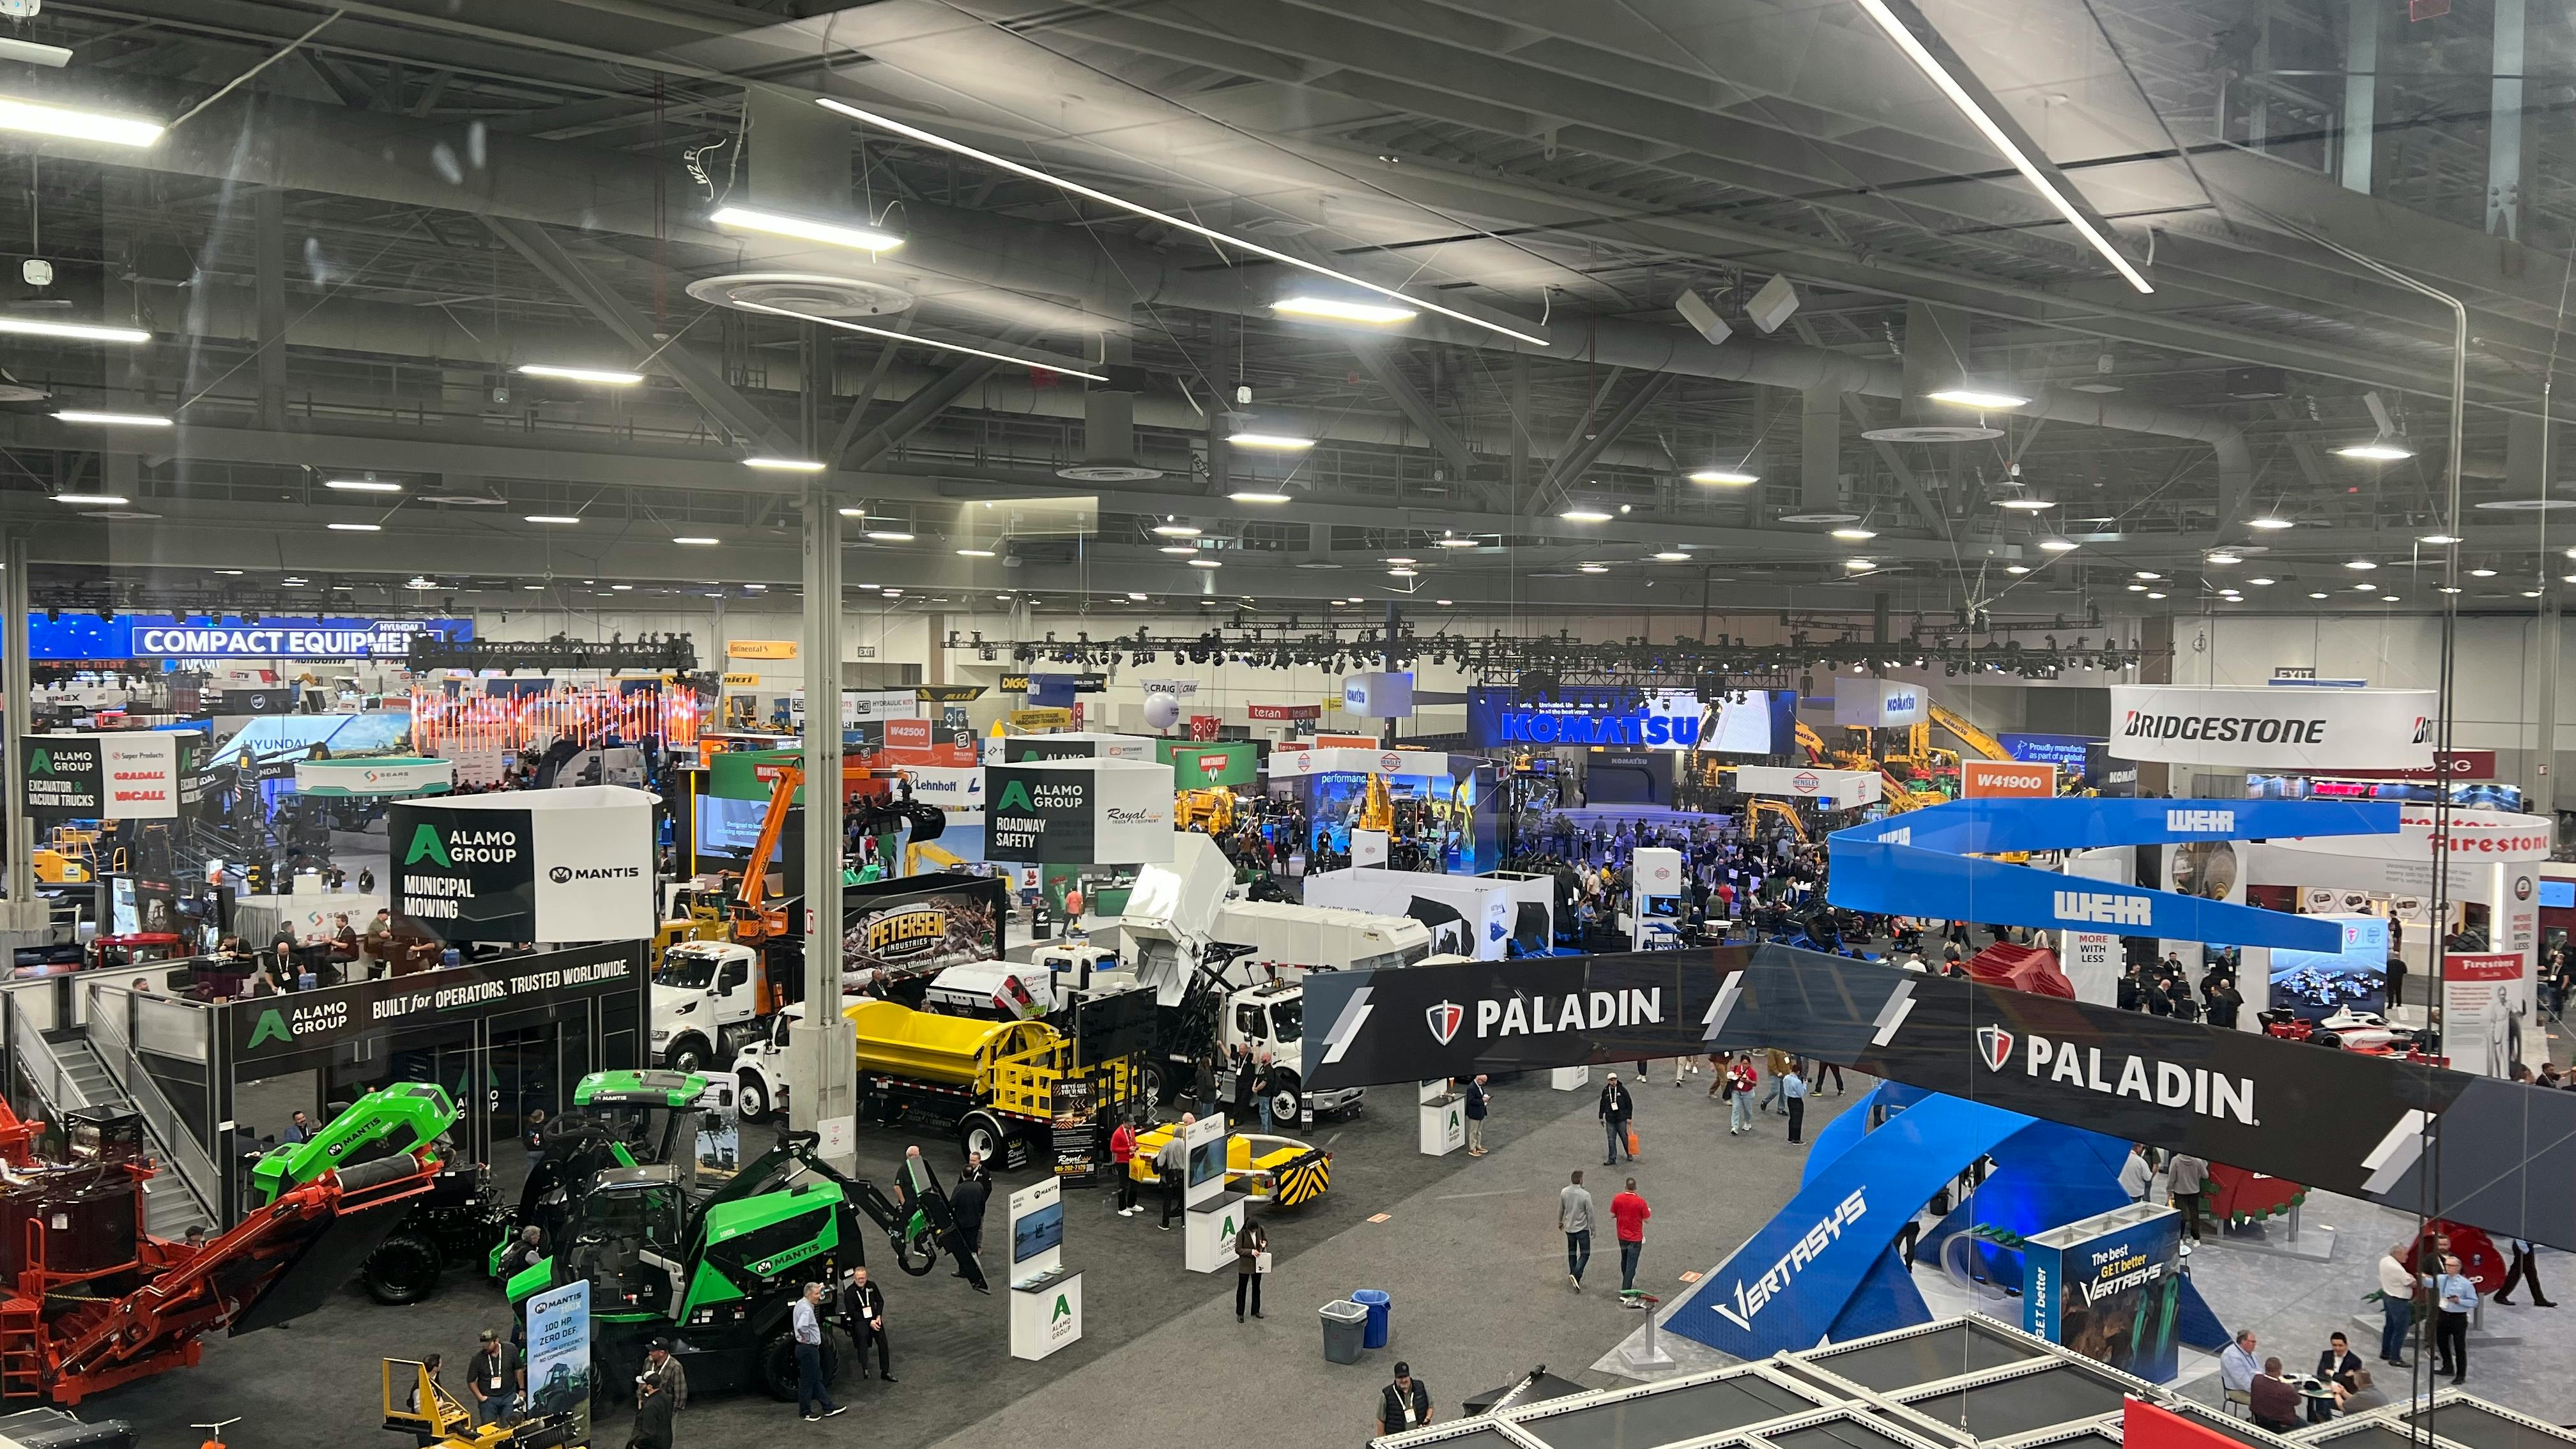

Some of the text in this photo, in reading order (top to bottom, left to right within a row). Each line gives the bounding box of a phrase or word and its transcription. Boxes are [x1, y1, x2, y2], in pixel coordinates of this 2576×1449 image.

[379, 623, 418, 631] HYUNDAI
[144, 630, 434, 654] COMPACT EQUIPMEN
[858, 647, 875, 657] EXIT
[2278, 670, 2312, 678] EXIT
[1001, 677, 1029, 689] DIGG
[1150, 684, 1176, 693] CRAIG
[46, 694, 80, 702] SIMEX
[1346, 688, 1365, 703] KOMATSU
[1887, 694, 1915, 711] KOMATSU
[1254, 707, 1308, 718] teran teran
[890, 726, 926, 737] W42500
[1501, 708, 1698, 745] KOMATSU
[1942, 717, 1969, 736] KOMATSU
[2124, 710, 2327, 744] BRIDGESTONE
[1794, 730, 1815, 742] MATSU
[2030, 742, 2053, 754] Proudly
[53, 751, 92, 761] ALAMO
[54, 762, 93, 772] GROUP
[114, 770, 165, 780] GRADALL
[1321, 774, 1367, 785] performanc
[1977, 773, 2042, 790] W41900
[29, 779, 83, 793] EXCAVATOR &
[916, 779, 957, 792] Lehnhoff
[1793, 778, 1820, 787] HENSLEY
[114, 790, 165, 802] VACALL
[1034, 785, 1083, 796] ALAMO
[29, 793, 95, 807] VACUUM TRUCKS
[1034, 797, 1083, 808] GROUP
[1107, 808, 1147, 822] Royal
[2167, 809, 2235, 832] WEIR
[996, 816, 1046, 832] ROADWAY
[450, 831, 516, 846] ALAMO
[996, 832, 1036, 848] SAFETY
[450, 848, 517, 863] GROUP
[575, 866, 640, 880] MANTIS
[404, 875, 475, 898] MUNICIPAL
[404, 896, 459, 919] MOWING
[2053, 890, 2152, 926] WEIR
[870, 912, 944, 951] PETERSEN
[887, 939, 928, 952] INDUSTRIES
[2079, 935, 2108, 943] MORE
[2082, 954, 2104, 963] LESS
[2462, 959, 2515, 970] Firestone
[372, 959, 630, 1020] BUILT for OPERATORS. TRUSTED WORLDWIDE.
[291, 1000, 347, 1022] ALAMO
[1476, 986, 1661, 1039] PALADIN
[292, 1015, 347, 1036] GROUP
[2027, 1034, 2254, 1126] PALADIN
[342, 1116, 381, 1146] MANTIS
[1057, 1154, 1082, 1163] Royal
[1041, 1184, 1059, 1195] MANTIS
[774, 1243, 820, 1267] MANTIS
[1710, 1186, 1867, 1333] VERTASYS
[2091, 1243, 2128, 1266] The best
[2121, 1254, 2147, 1272] better
[2035, 1266, 2047, 1307] better
[2080, 1263, 2163, 1308] VERTASYS
[548, 1292, 582, 1308] MANTIS
[545, 1321, 559, 1333] 100
[1052, 1317, 1071, 1333] ALAMO
[539, 1332, 560, 1346] ZERO
[1052, 1325, 1071, 1340] GROUP
